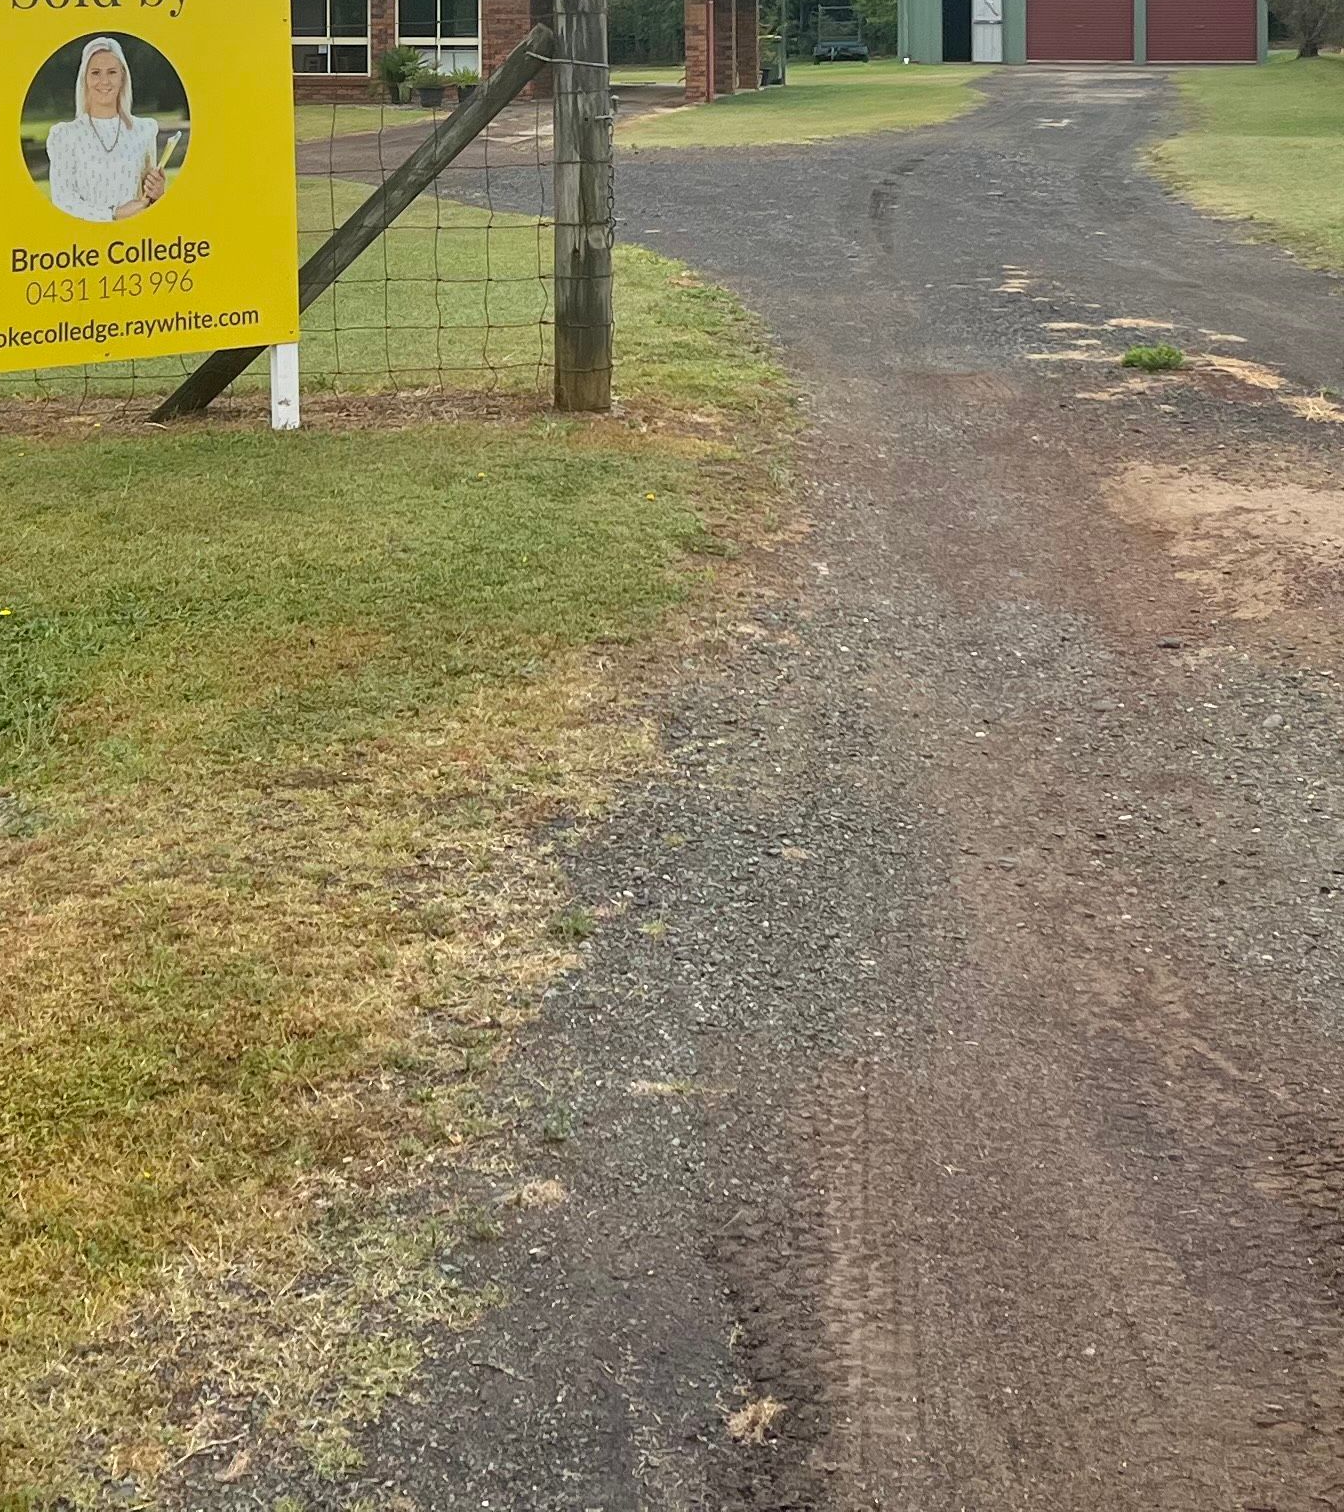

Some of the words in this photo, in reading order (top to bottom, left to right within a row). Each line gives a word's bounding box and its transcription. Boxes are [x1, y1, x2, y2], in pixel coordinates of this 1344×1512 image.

[11, 243, 100, 273] Brooke
[107, 235, 211, 264] Colledge
[25, 277, 89, 306] 0431
[98, 272, 143, 300] 143
[149, 268, 194, 296] 996
